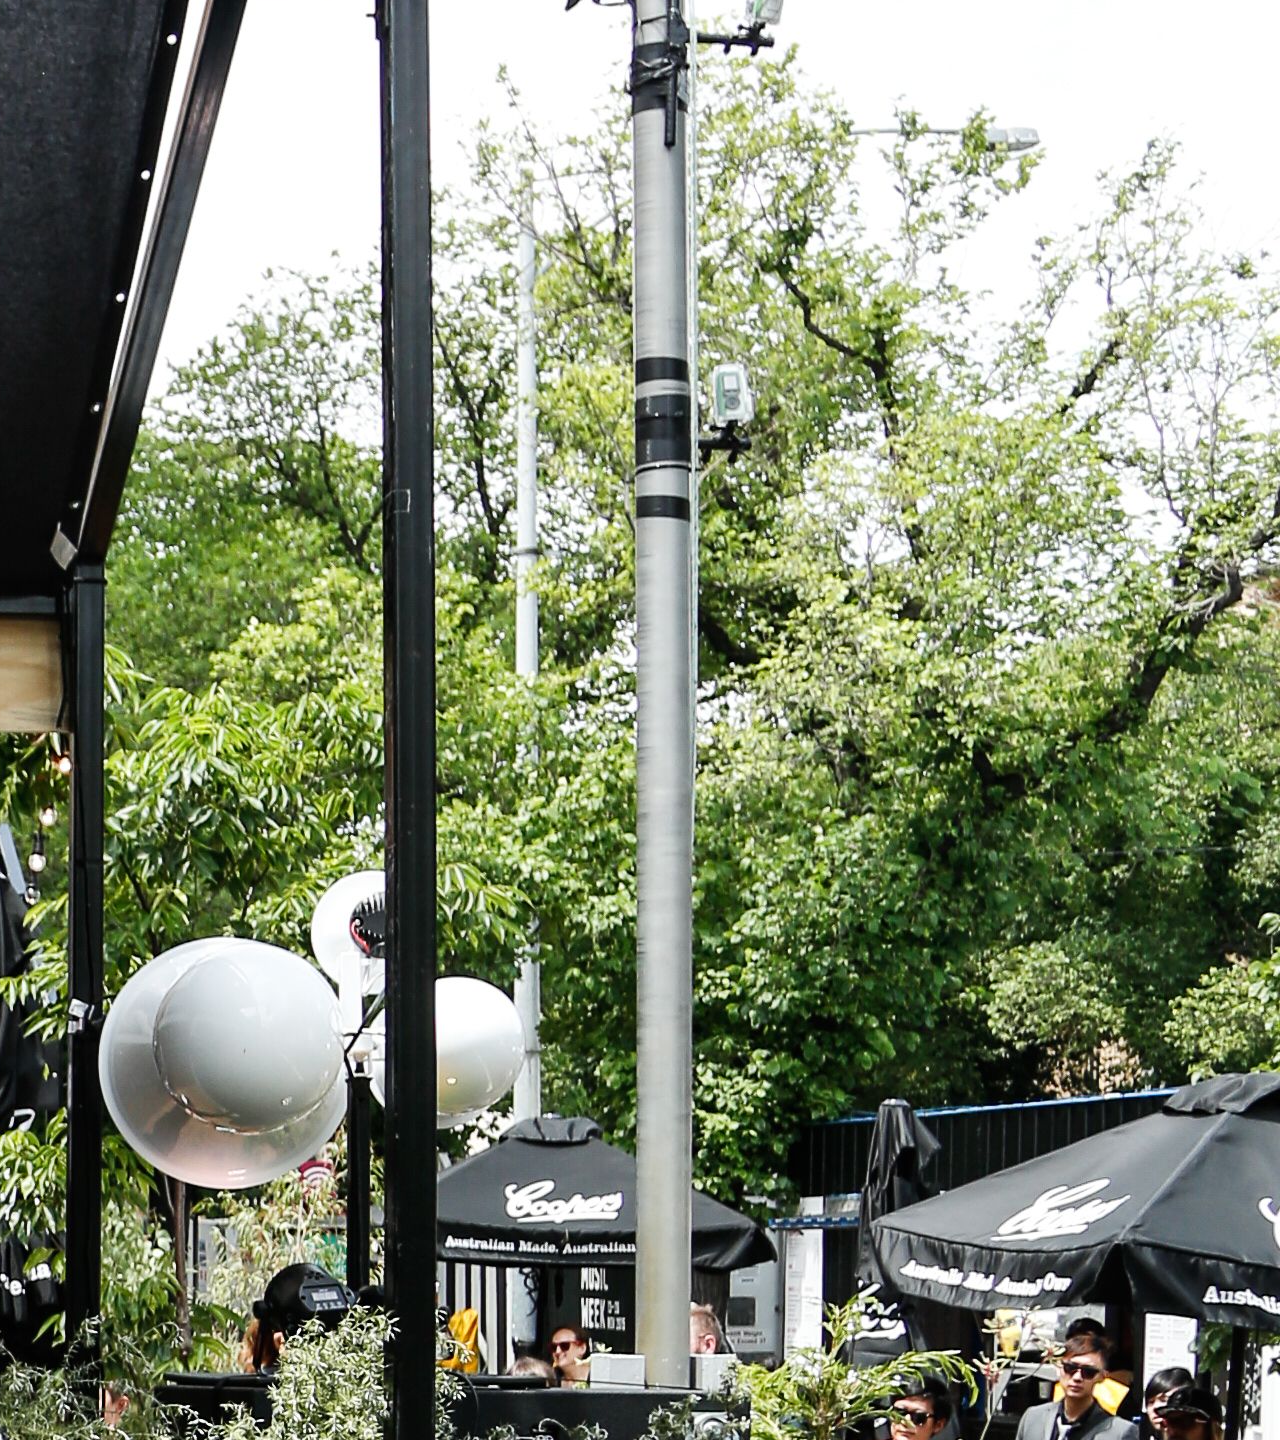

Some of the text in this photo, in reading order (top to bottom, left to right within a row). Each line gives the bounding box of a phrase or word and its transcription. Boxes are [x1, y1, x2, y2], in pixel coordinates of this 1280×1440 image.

[504, 1179, 624, 1221] Coopers
[444, 1234, 637, 1256] Australian Made. Australian
[580, 1297, 606, 1329] WEEK
